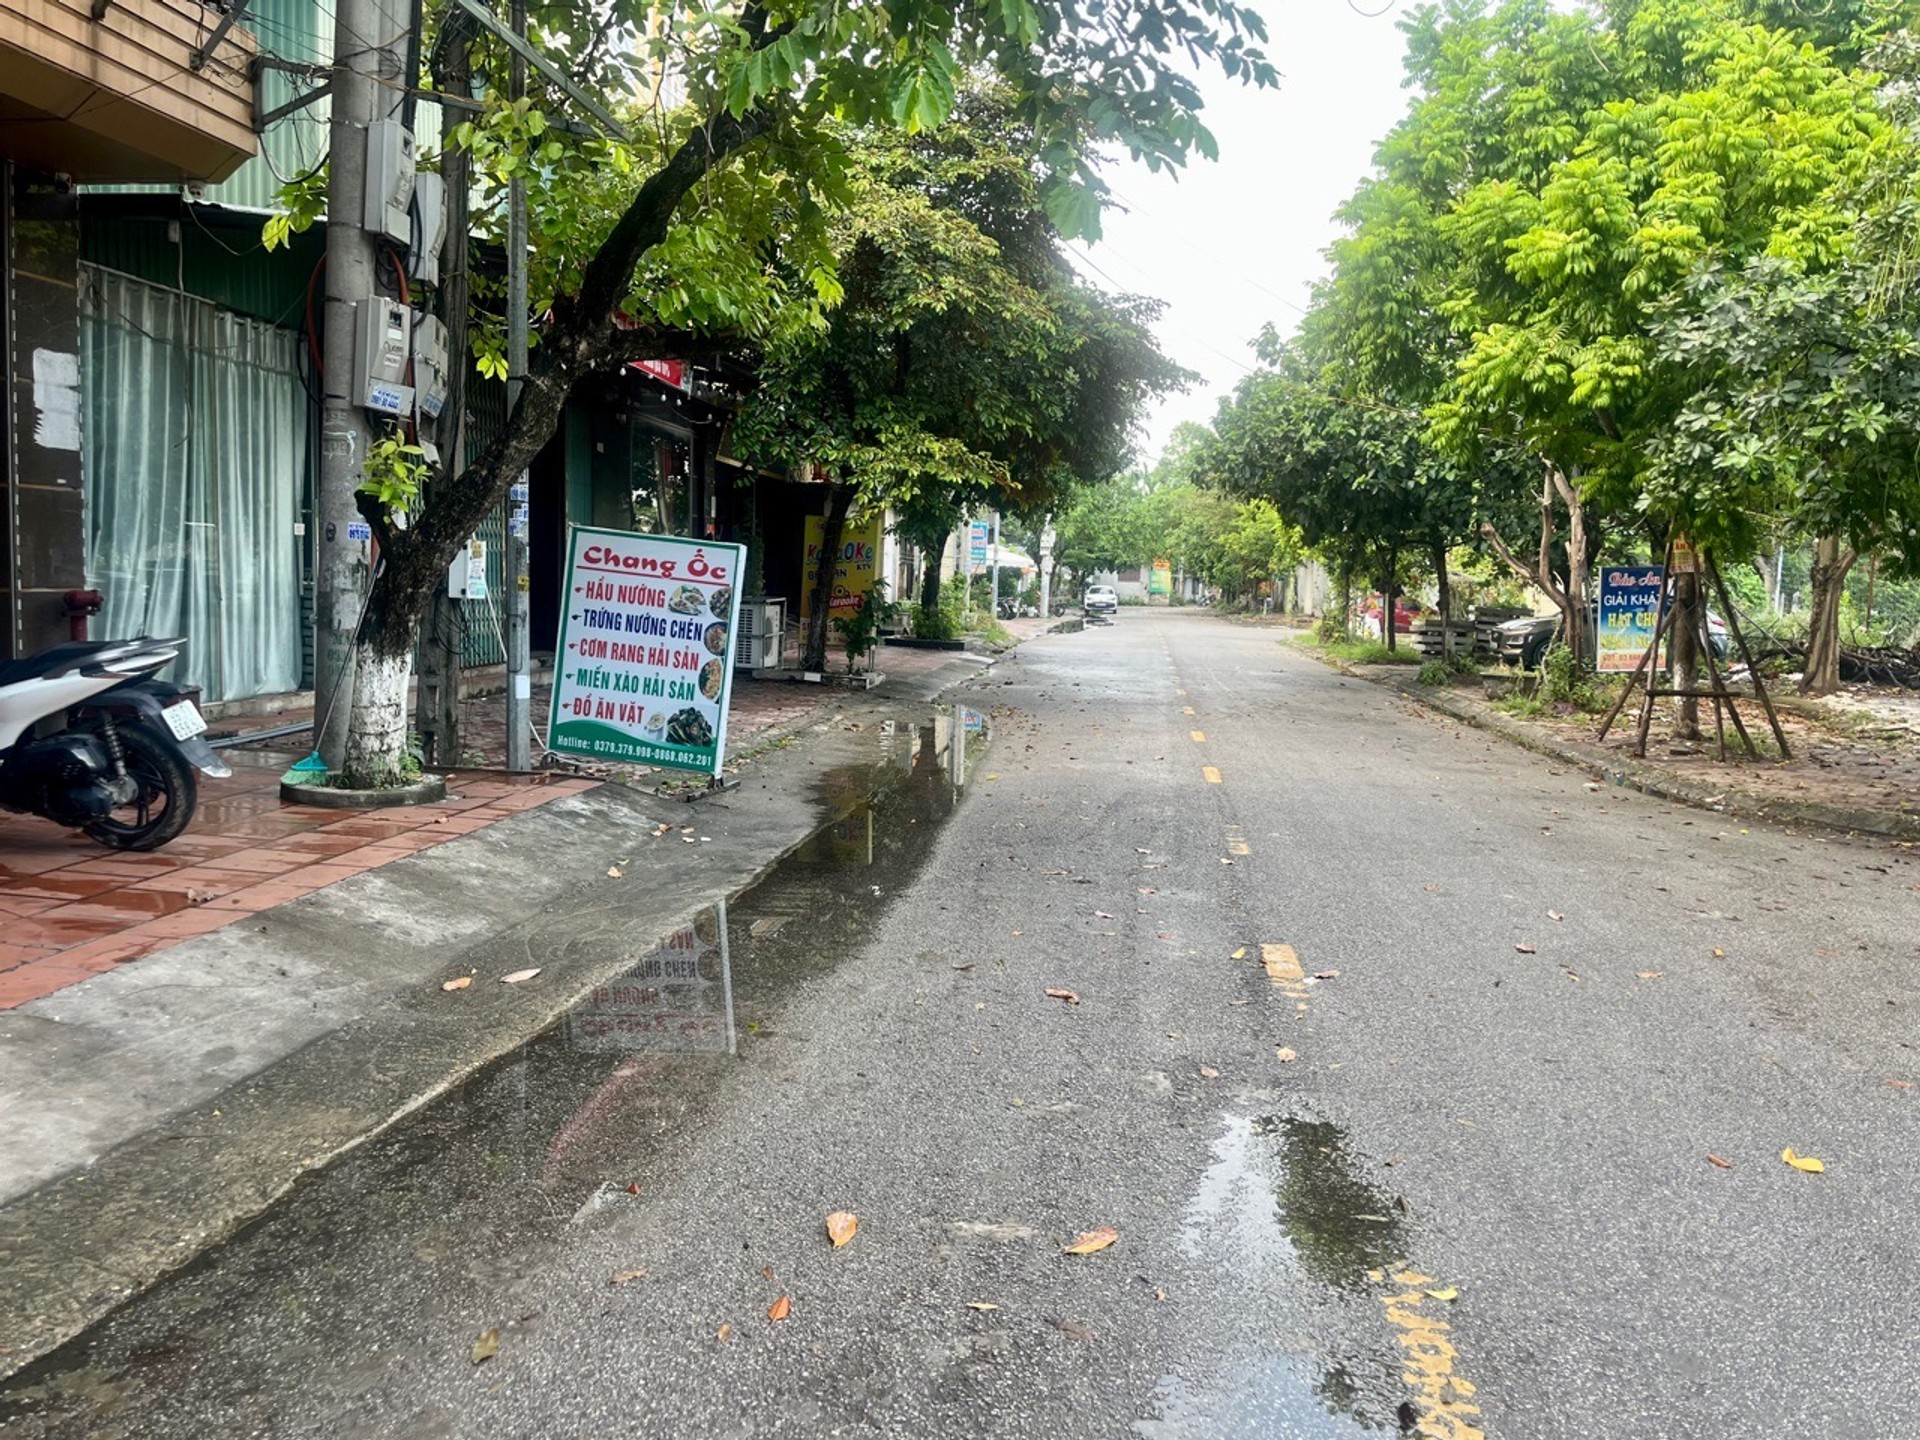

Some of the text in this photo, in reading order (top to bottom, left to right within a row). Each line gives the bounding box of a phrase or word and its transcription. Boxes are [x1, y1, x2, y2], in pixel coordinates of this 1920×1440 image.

[583, 546, 726, 579] Chang Ốc
[617, 584, 666, 609] NƯỚNG
[1603, 590, 1628, 606] GIẢI
[583, 607, 703, 641] TRỨNG NƯỚNG CHÉN
[579, 638, 699, 671] CƠM RANG HẢI SẢN
[576, 665, 696, 702] MIẾN XÀO HẢI SẢN
[595, 697, 615, 720] ĂN
[619, 701, 645, 727] VẶT
[556, 734, 591, 750] Hotline:
